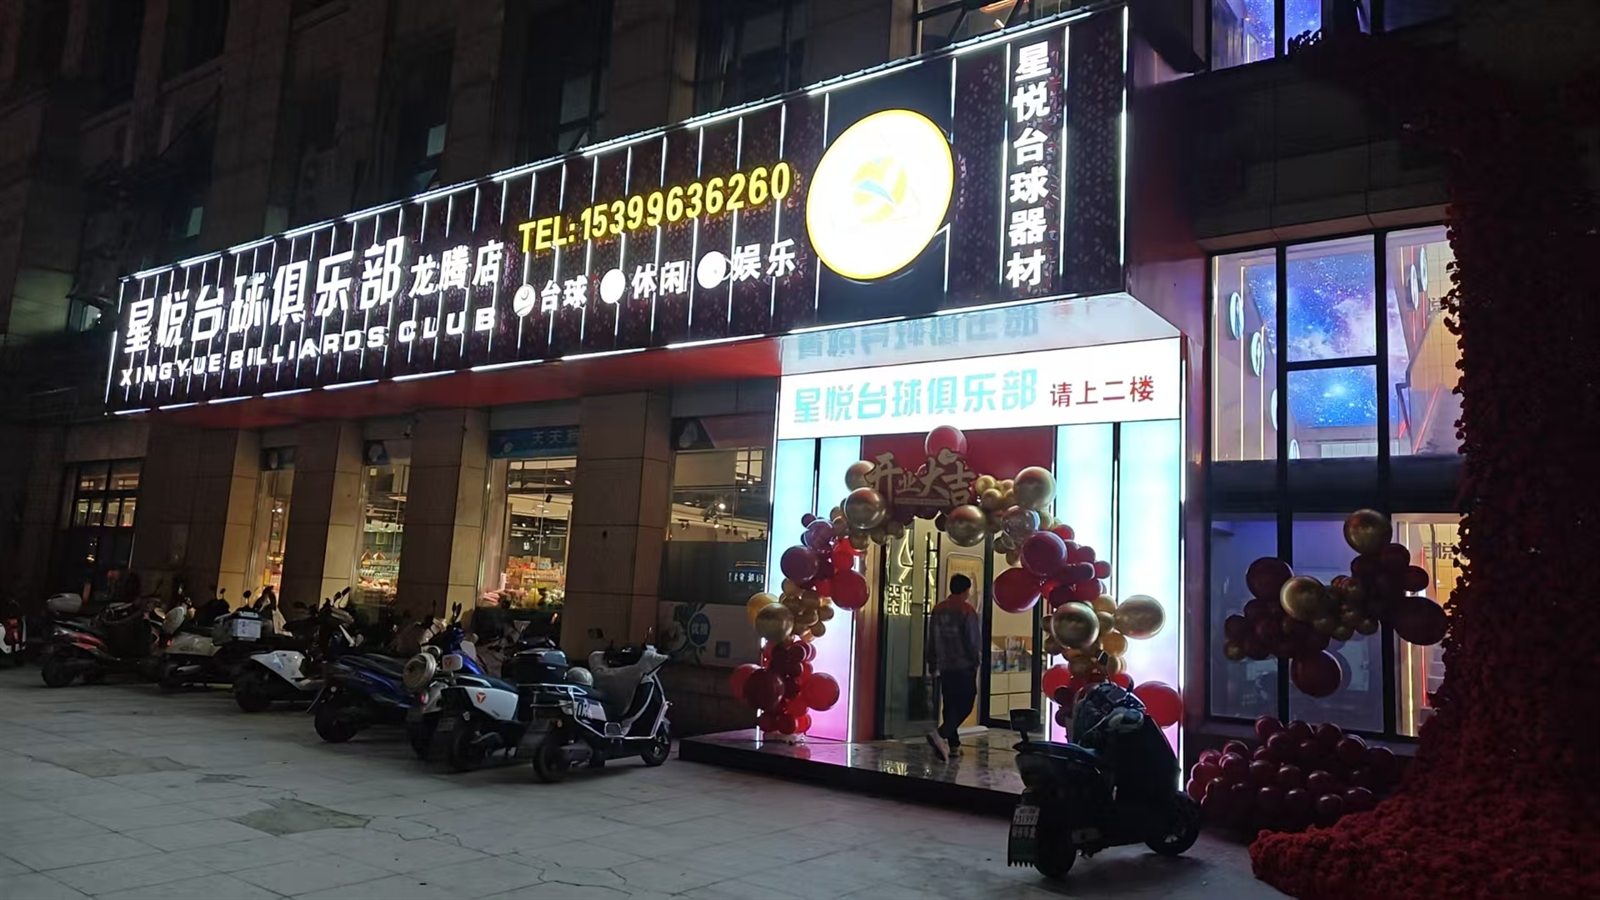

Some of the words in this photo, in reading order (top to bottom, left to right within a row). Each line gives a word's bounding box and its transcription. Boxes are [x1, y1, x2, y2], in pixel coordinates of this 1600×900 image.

[1006, 41, 1051, 288] 星悦台球器材
[518, 162, 791, 253] TEL:15399636260
[124, 236, 406, 354] 星悦台球俱乐部
[409, 240, 504, 299] 龙腾店
[540, 275, 589, 312] 台球
[631, 260, 690, 299] 休闲
[731, 239, 796, 282] 娱乐
[120, 355, 222, 387] XINGYUE
[229, 327, 388, 370] BILLIARDS
[398, 308, 496, 343] CLUB
[793, 369, 1038, 424] 星悦台球俱乐部
[1050, 375, 1155, 409] 请上二楼
[865, 451, 977, 508] 开业大吉
